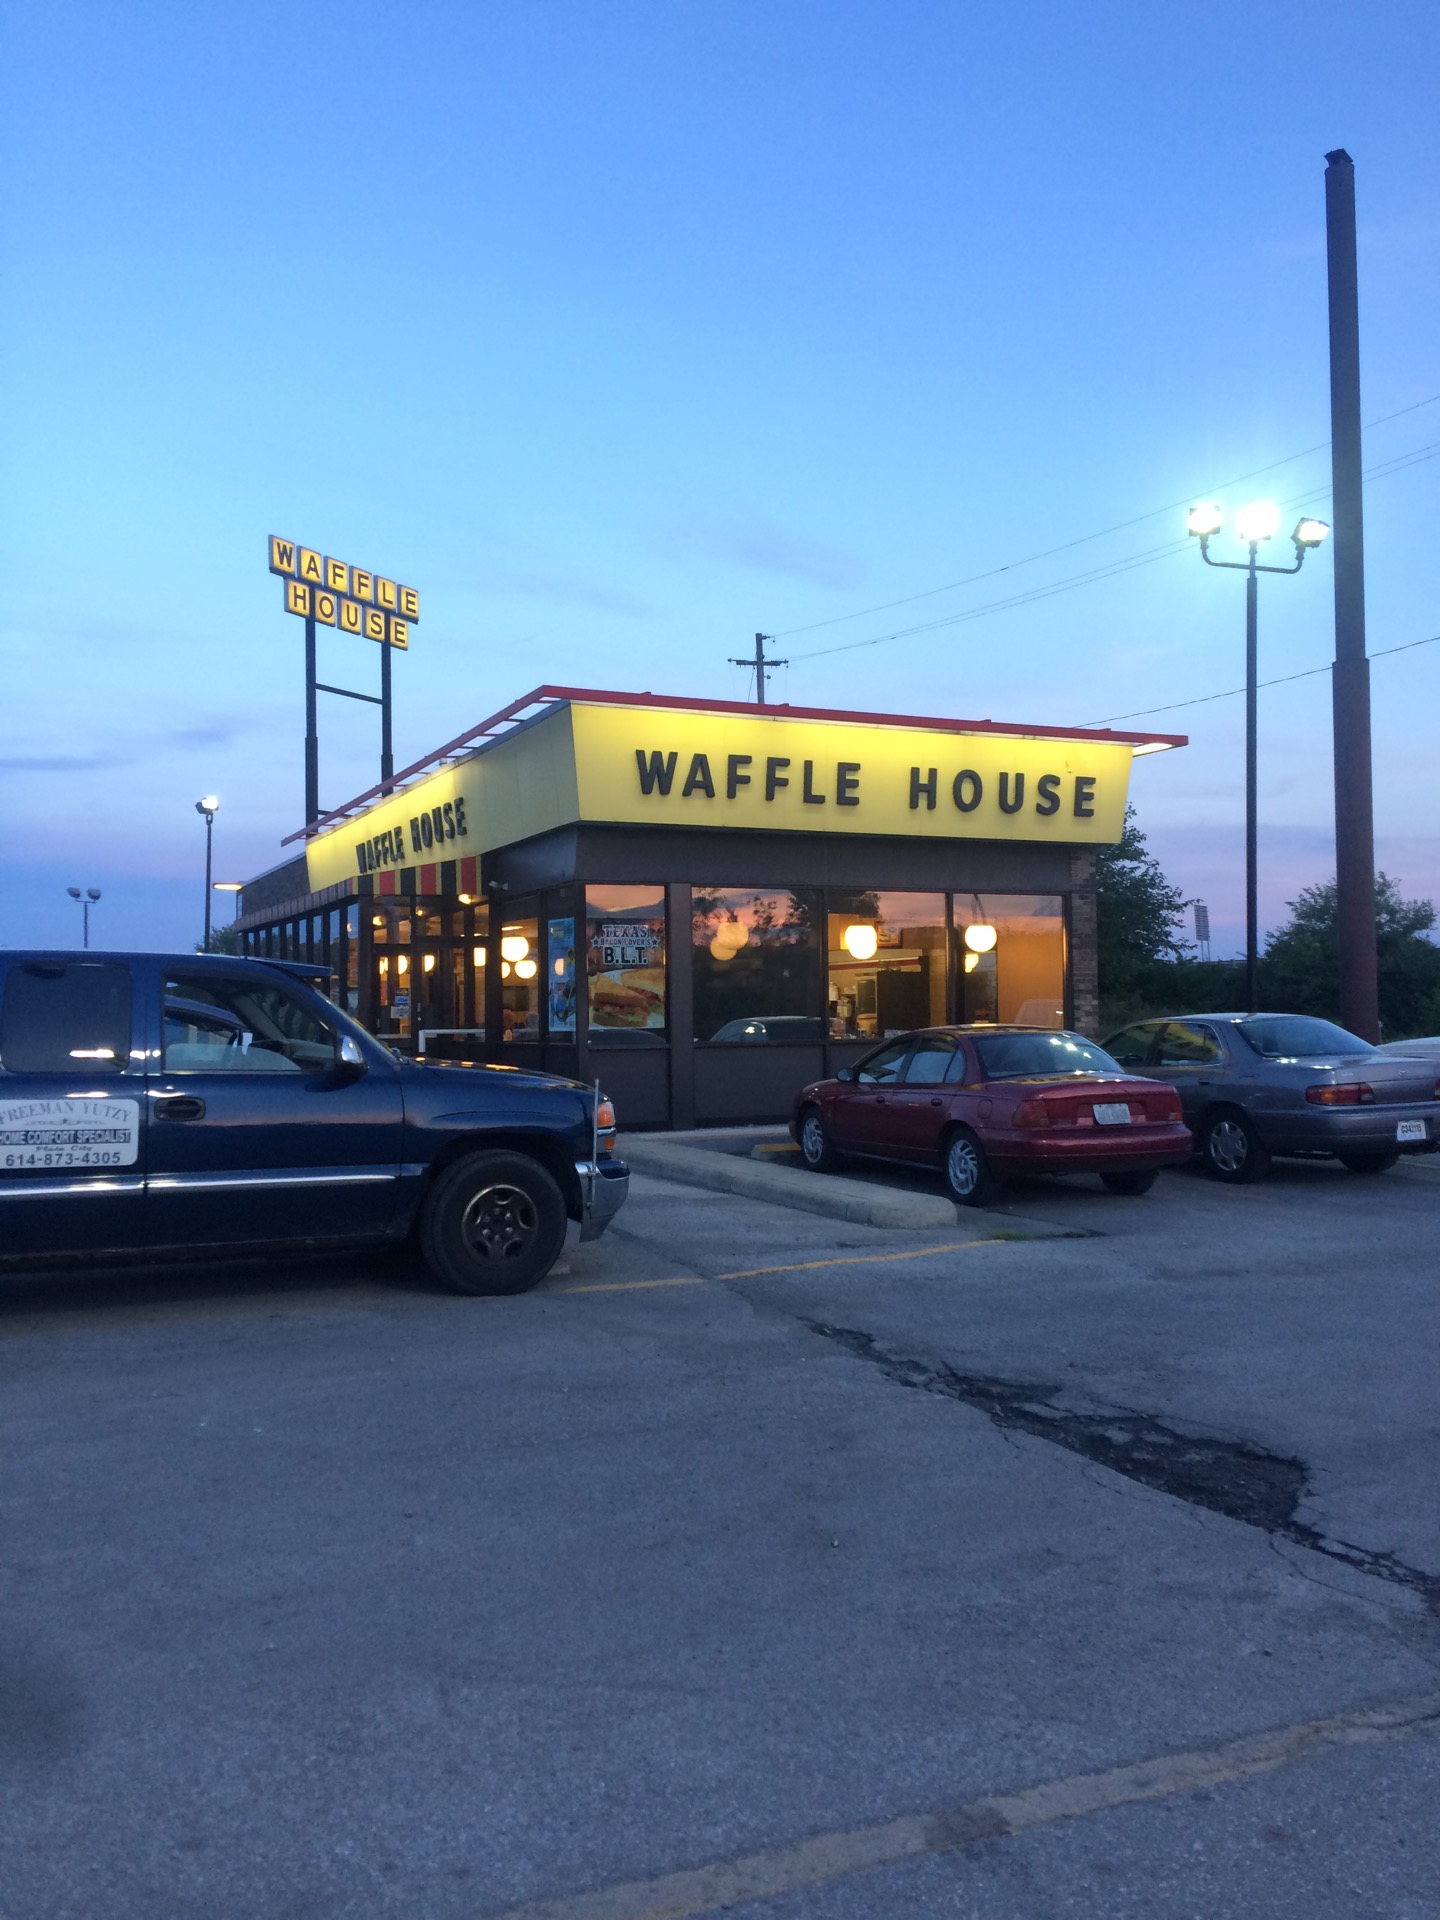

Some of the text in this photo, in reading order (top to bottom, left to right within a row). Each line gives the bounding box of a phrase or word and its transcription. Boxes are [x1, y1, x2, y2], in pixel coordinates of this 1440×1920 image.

[276, 541, 417, 614] WAFFLE
[293, 585, 406, 644] HOUSE
[635, 749, 1097, 817] WAFFLE HOUSE
[355, 797, 467, 874] WAFFLE HOUSE
[602, 925, 649, 938] TEXAS
[625, 938, 651, 946] LOVER'S
[604, 947, 648, 964] B.L.T.
[82, 1101, 131, 1122] YUTZY
[28, 1130, 75, 1144] COMFORT
[5, 1152, 121, 1167] 614-873-4305
